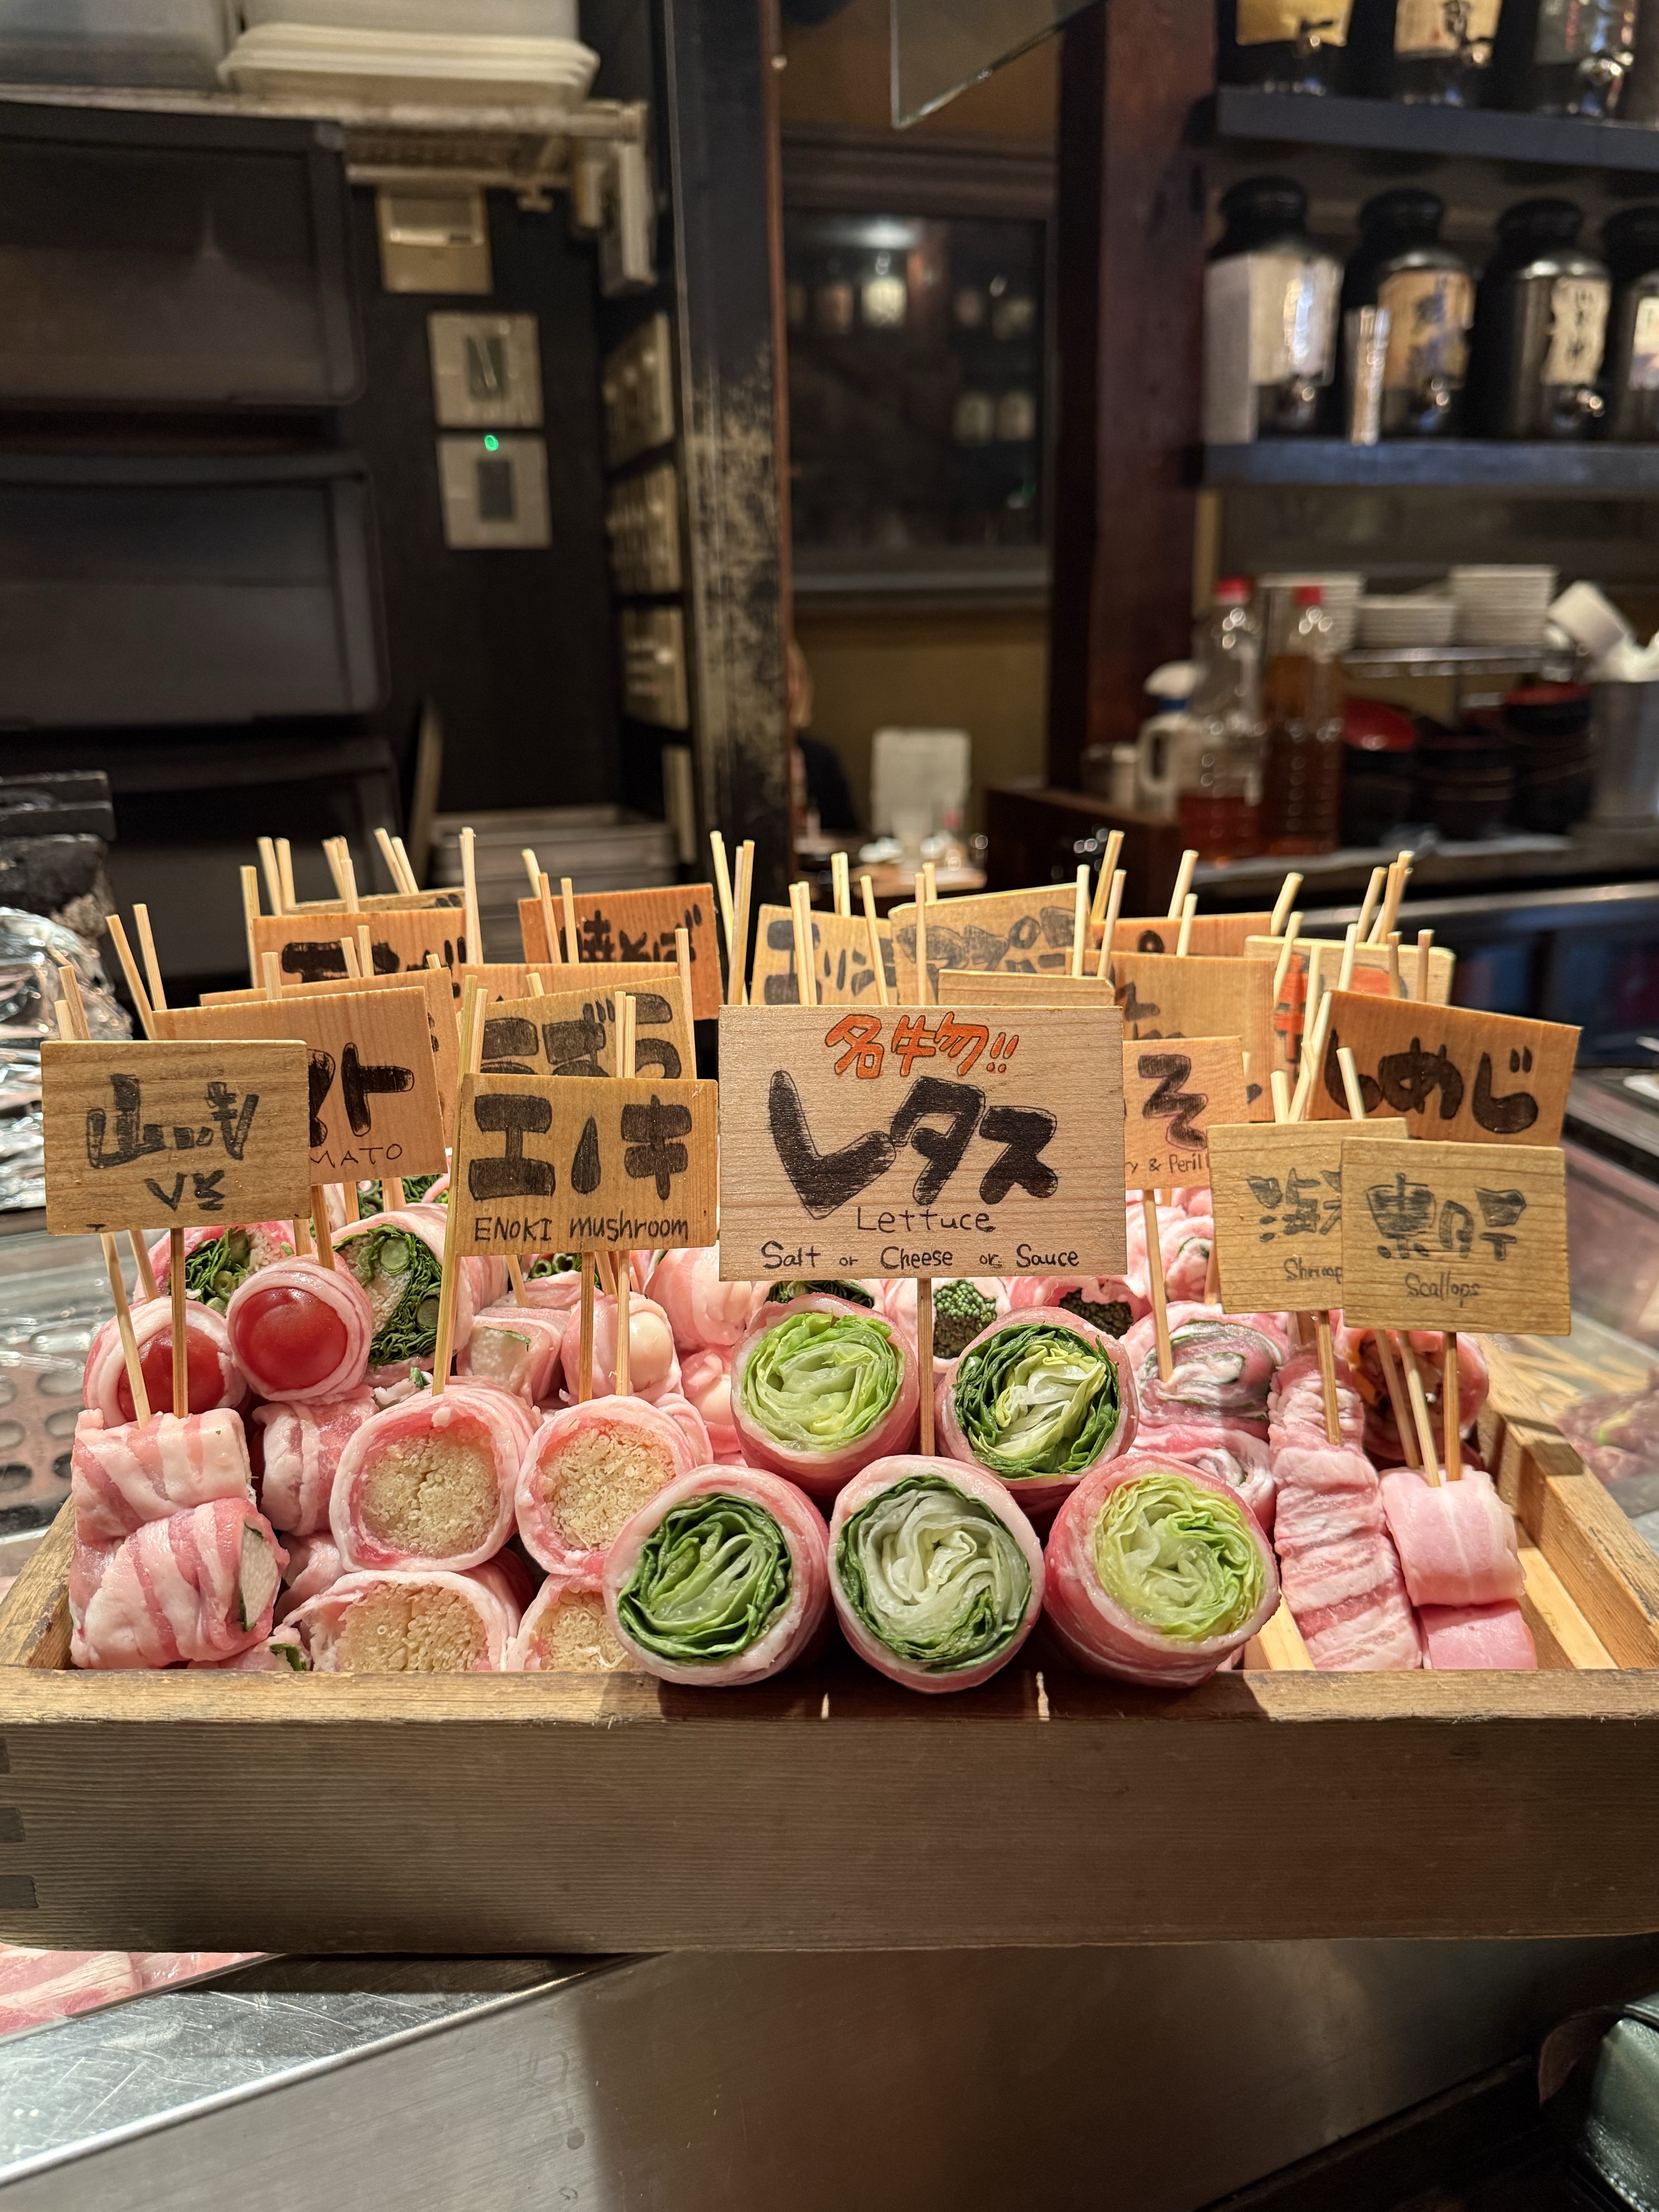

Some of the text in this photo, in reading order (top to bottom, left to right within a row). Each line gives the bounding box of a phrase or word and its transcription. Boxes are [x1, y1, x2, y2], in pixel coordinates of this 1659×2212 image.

[1324, 1029, 1538, 1134] しめじ
[469, 1093, 692, 1201] エノキ
[769, 1070, 1058, 1219] レタス
[1149, 1158, 1161, 1171] &
[474, 1210, 689, 1242] ENOKI mushroom
[857, 1207, 996, 1232] Lettuce
[761, 1241, 821, 1269] Salt
[839, 1255, 858, 1267] or
[880, 1246, 953, 1270] Cheese
[1016, 1244, 1080, 1268] Sauce
[1405, 1271, 1481, 1307] Scallops
